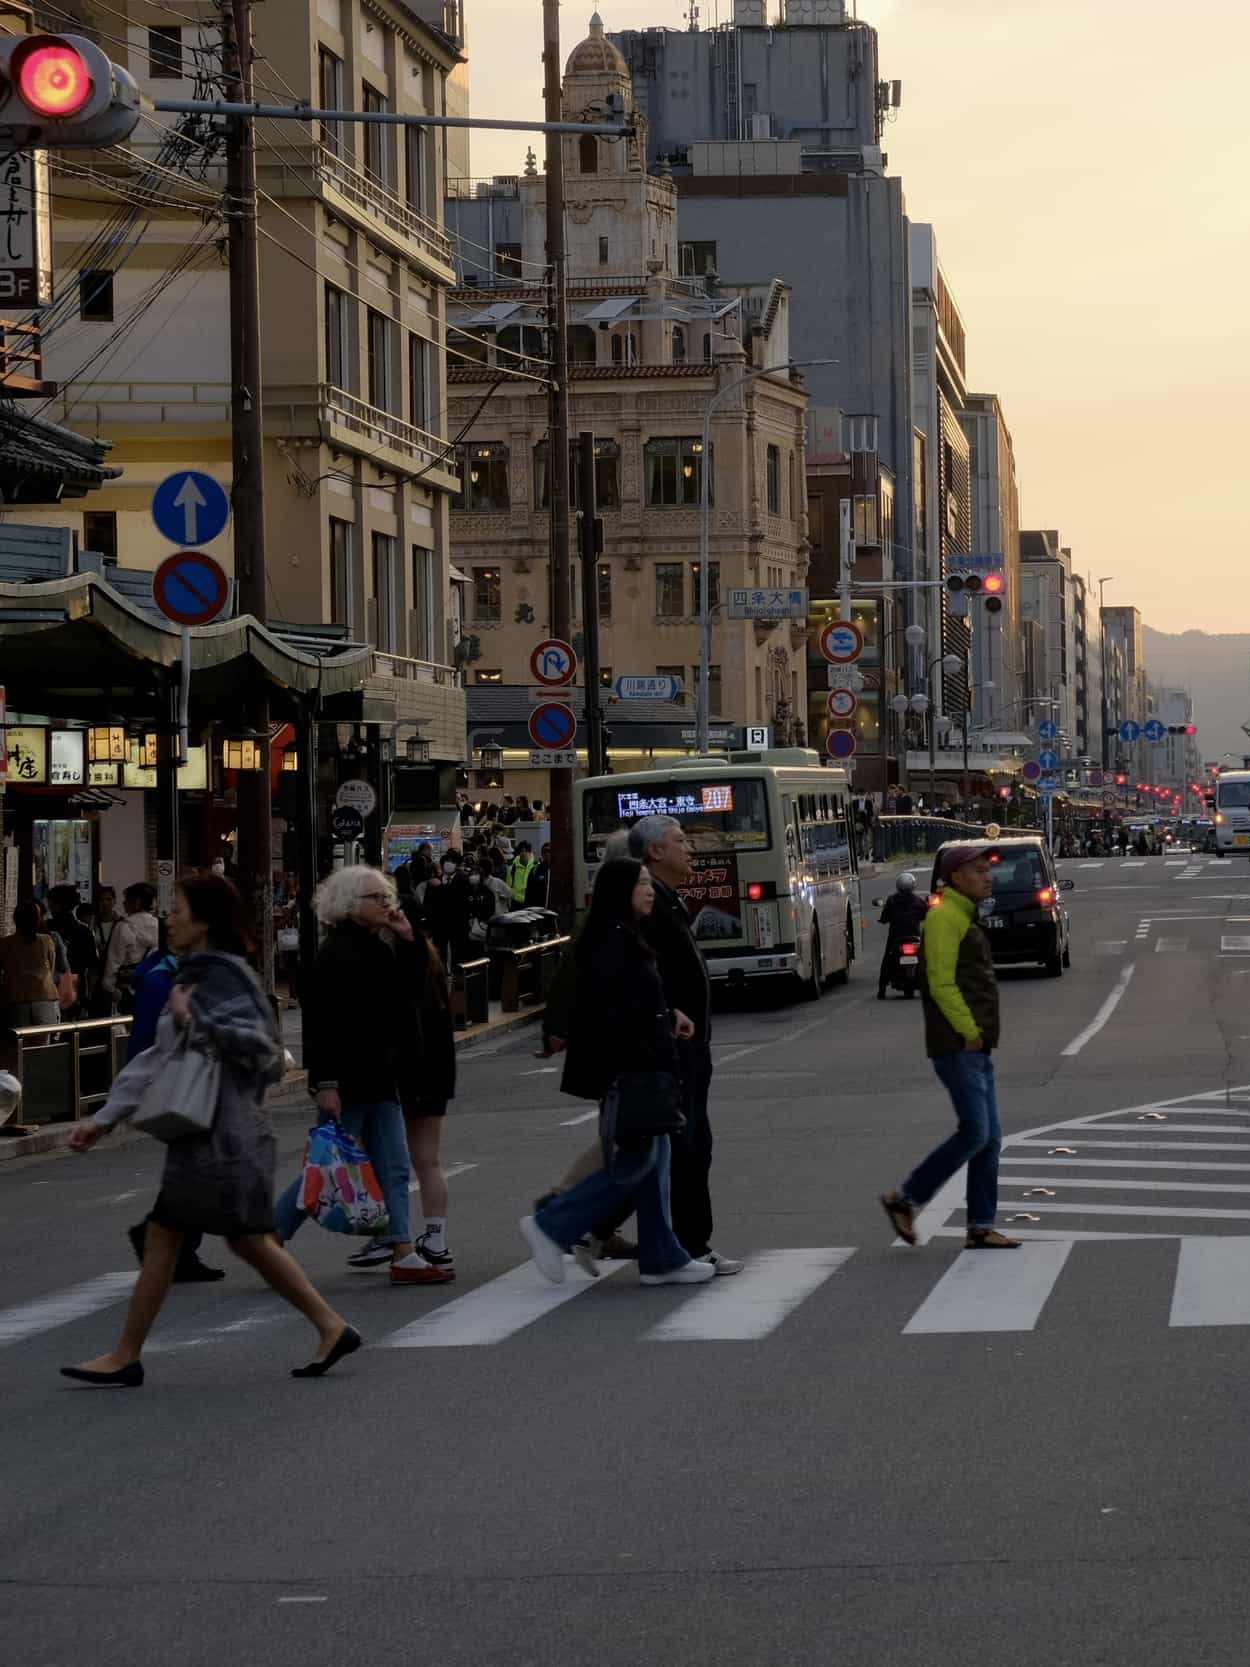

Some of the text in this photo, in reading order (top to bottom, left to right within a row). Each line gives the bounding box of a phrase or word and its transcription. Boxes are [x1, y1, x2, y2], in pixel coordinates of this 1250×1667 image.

[531, 753, 576, 764] ここまで
[706, 790, 730, 809] 207
